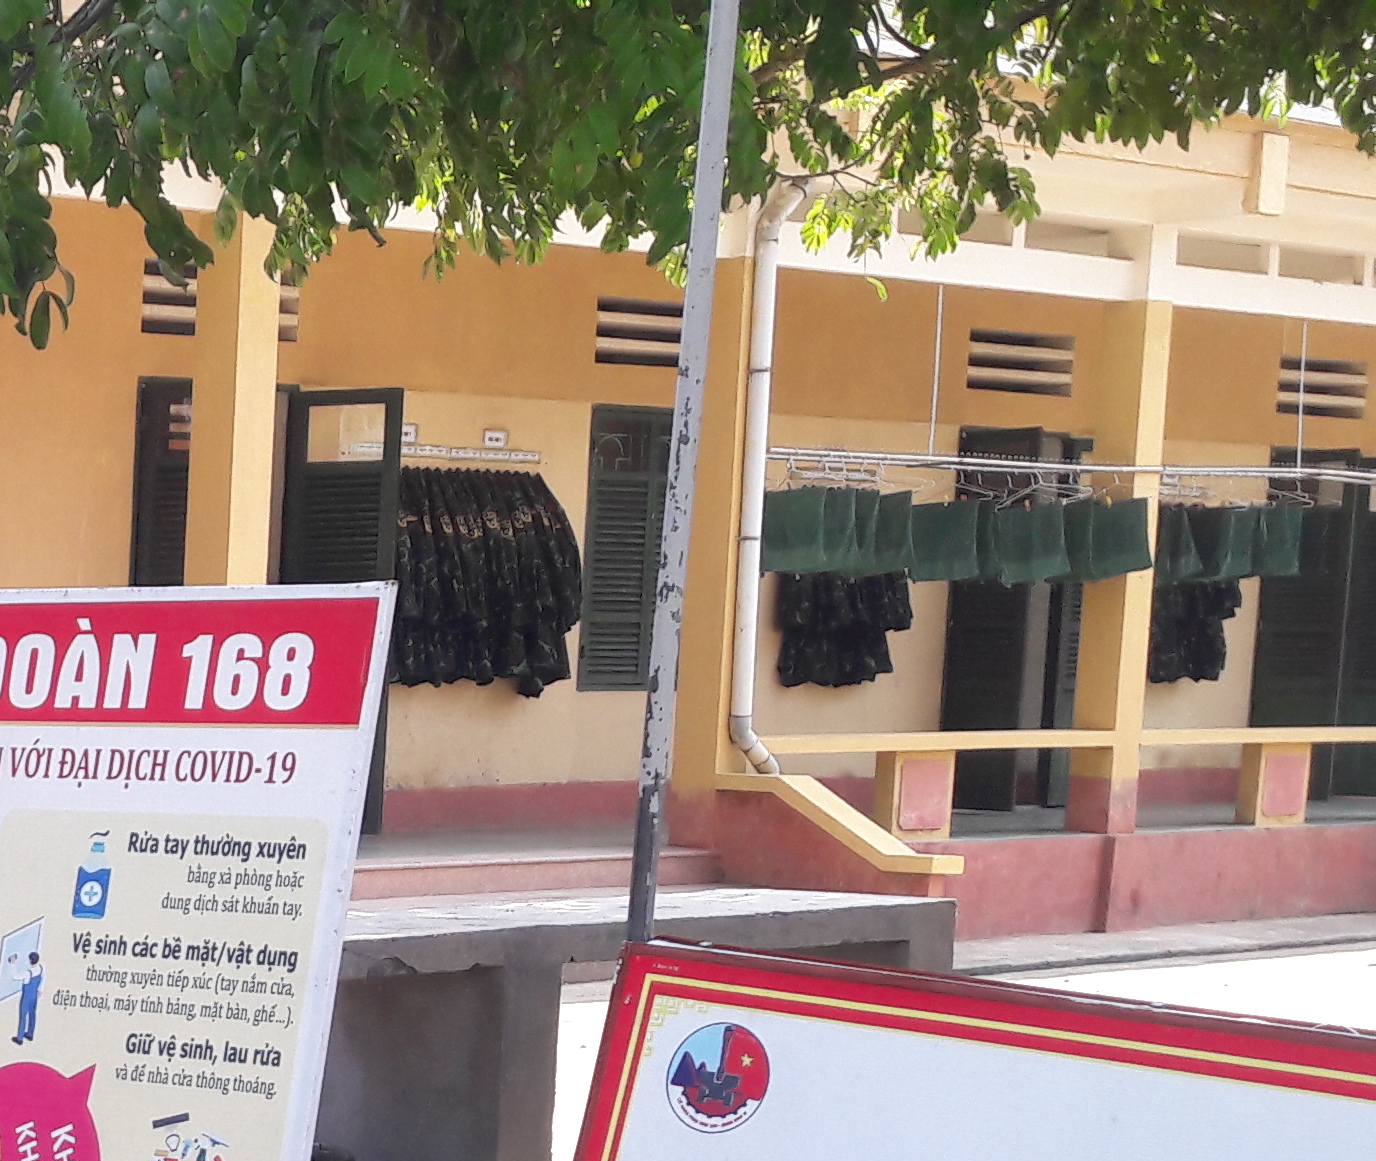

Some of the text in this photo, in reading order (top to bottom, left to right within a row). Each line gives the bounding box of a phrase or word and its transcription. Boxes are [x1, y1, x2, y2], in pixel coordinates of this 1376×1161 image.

[182, 633, 313, 711] 168
[11, 738, 53, 779] VỚI
[57, 748, 101, 788] ĐẠI
[106, 749, 169, 789] DỊCH
[175, 750, 295, 784] COVID-19
[128, 831, 306, 864] Rửa tay thường xuyên
[187, 863, 304, 892] bằng xà phòng hoặc
[161, 892, 301, 921] dung dịch sát khuẩn tay.
[73, 932, 298, 974] Vệ sinh các bề mặt/vật dụng
[126, 1033, 280, 1067] Giữ vệ sinh, lau rửa
